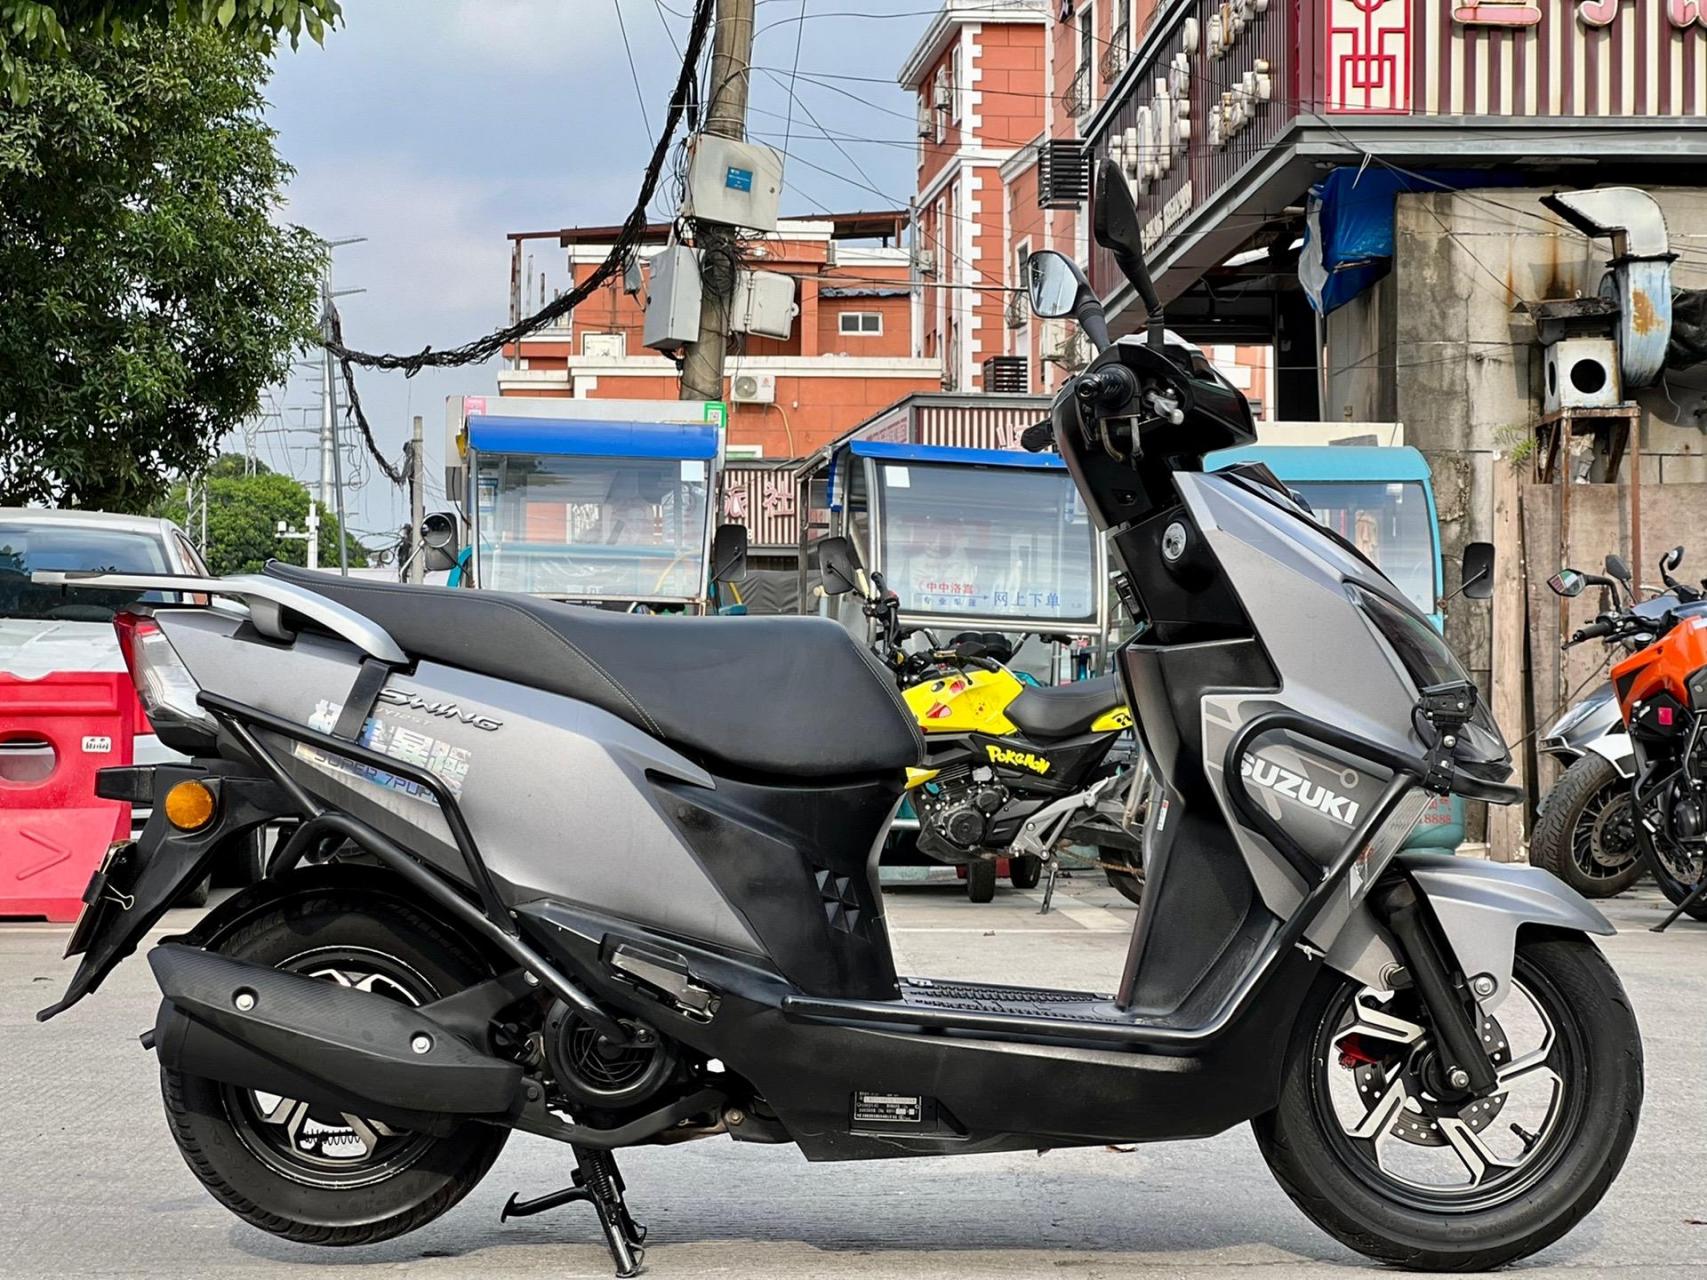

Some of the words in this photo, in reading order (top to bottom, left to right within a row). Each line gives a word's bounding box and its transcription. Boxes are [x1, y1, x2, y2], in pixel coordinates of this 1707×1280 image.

[993, 591, 1061, 609] 网上下单
[378, 687, 504, 732] SWING
[1240, 751, 1360, 825] SUZUKI
